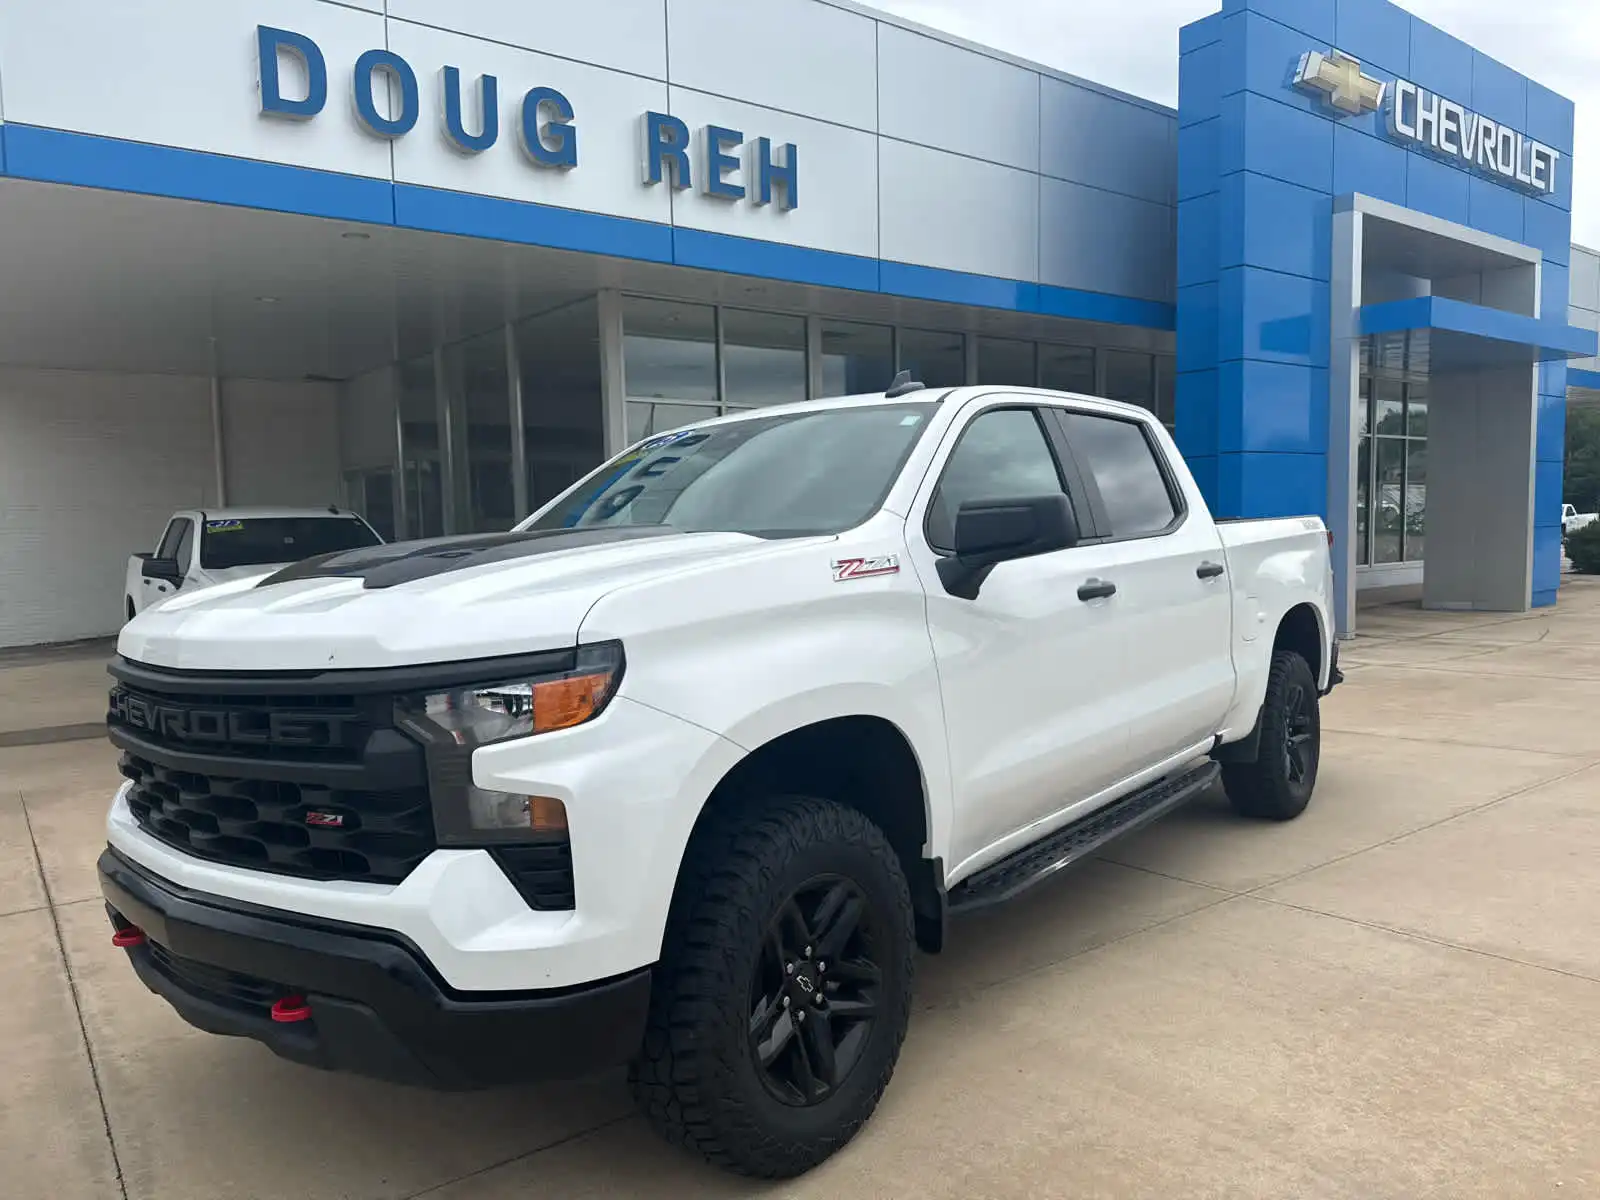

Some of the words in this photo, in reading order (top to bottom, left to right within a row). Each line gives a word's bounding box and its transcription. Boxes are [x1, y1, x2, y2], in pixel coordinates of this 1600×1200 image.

[257, 24, 578, 171] DOUG
[642, 111, 798, 211] REH
[1393, 79, 1559, 193] CHEVROLET
[832, 554, 899, 581] Z71
